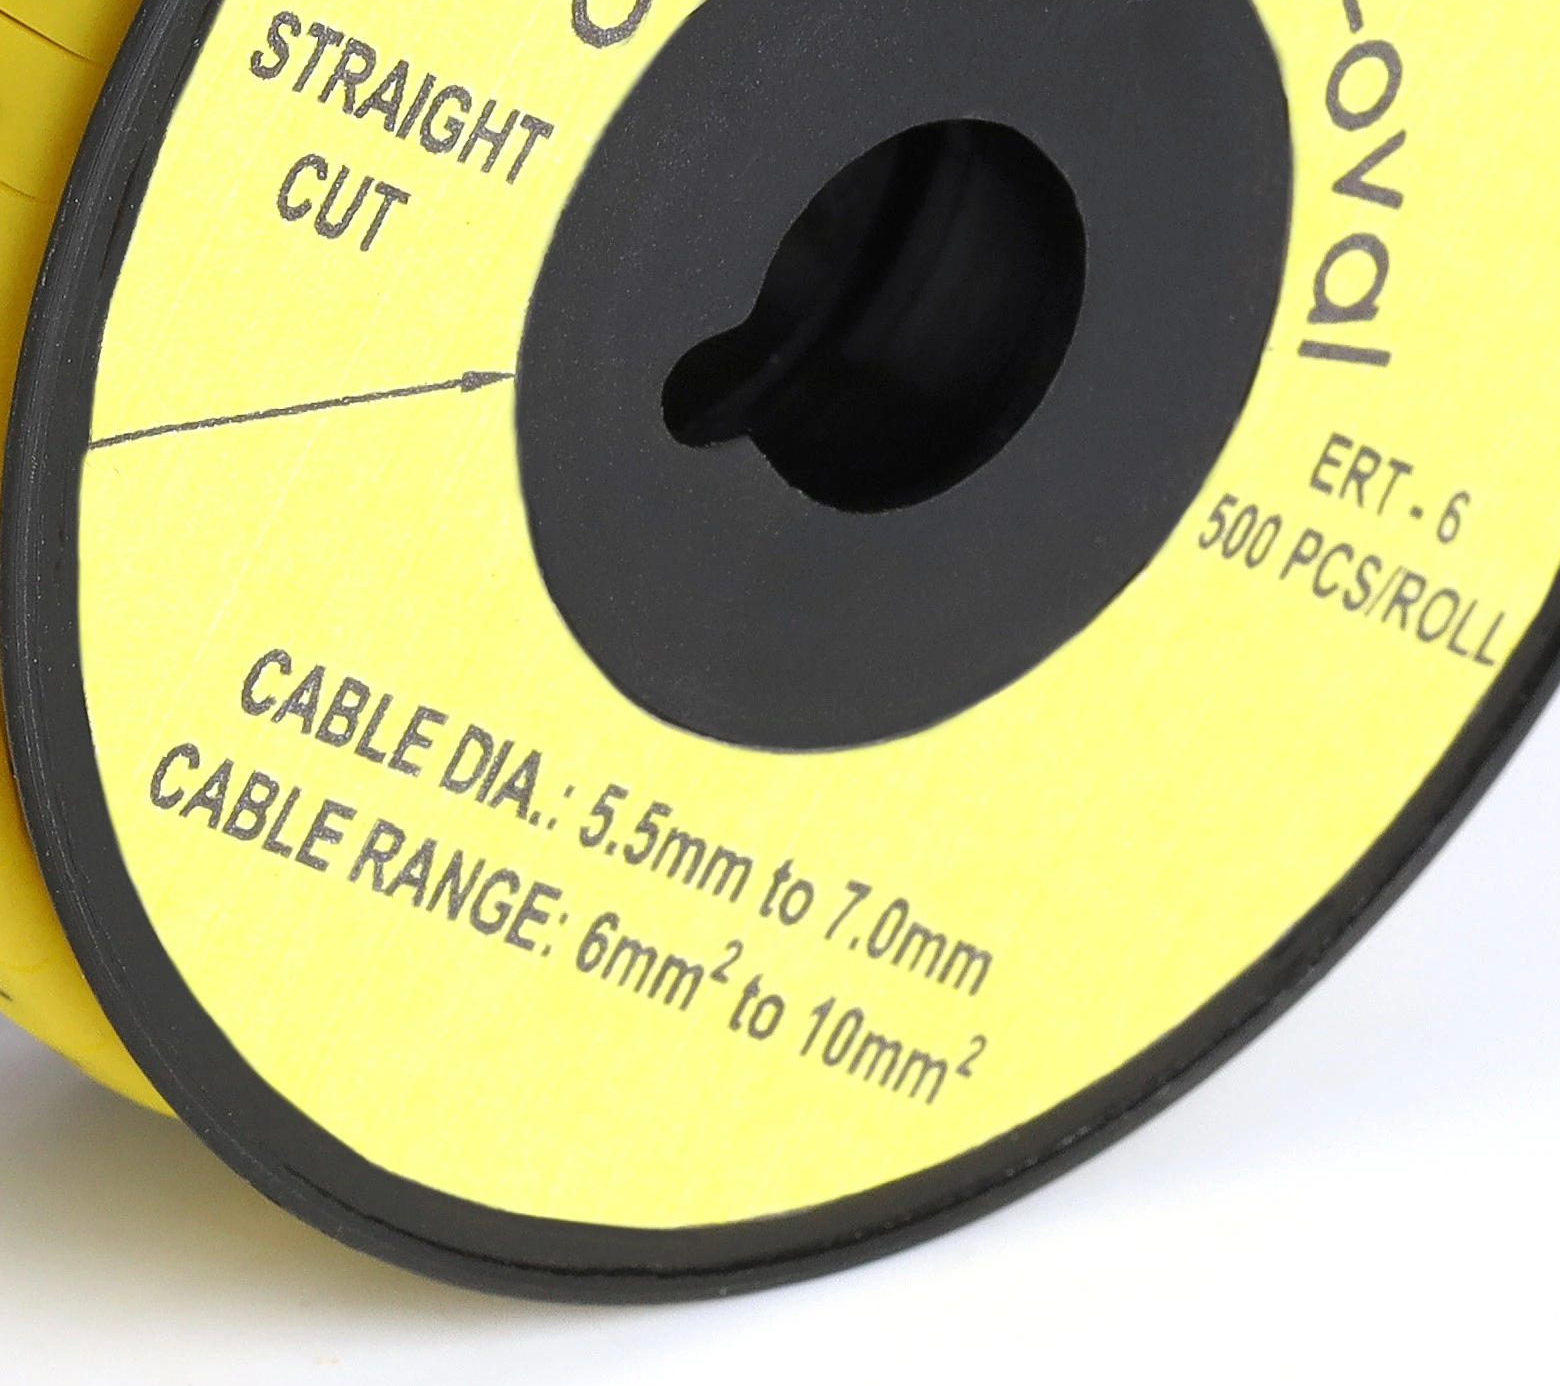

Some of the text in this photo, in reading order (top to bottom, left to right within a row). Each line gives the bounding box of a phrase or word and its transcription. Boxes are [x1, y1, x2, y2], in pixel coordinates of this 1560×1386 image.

[250, 12, 554, 183] STRAIGHT
[277, 154, 410, 251] CUT
[1198, 493, 1504, 667] 500 PCS/ROLL
[150, 744, 356, 871] CABLE
[350, 819, 568, 957] RANGE:
[730, 977, 784, 1039] to
[242, 649, 446, 775] CABLE
[580, 785, 752, 901] 5.5mm
[761, 861, 813, 924] to
[827, 882, 991, 994] 7.0mm
